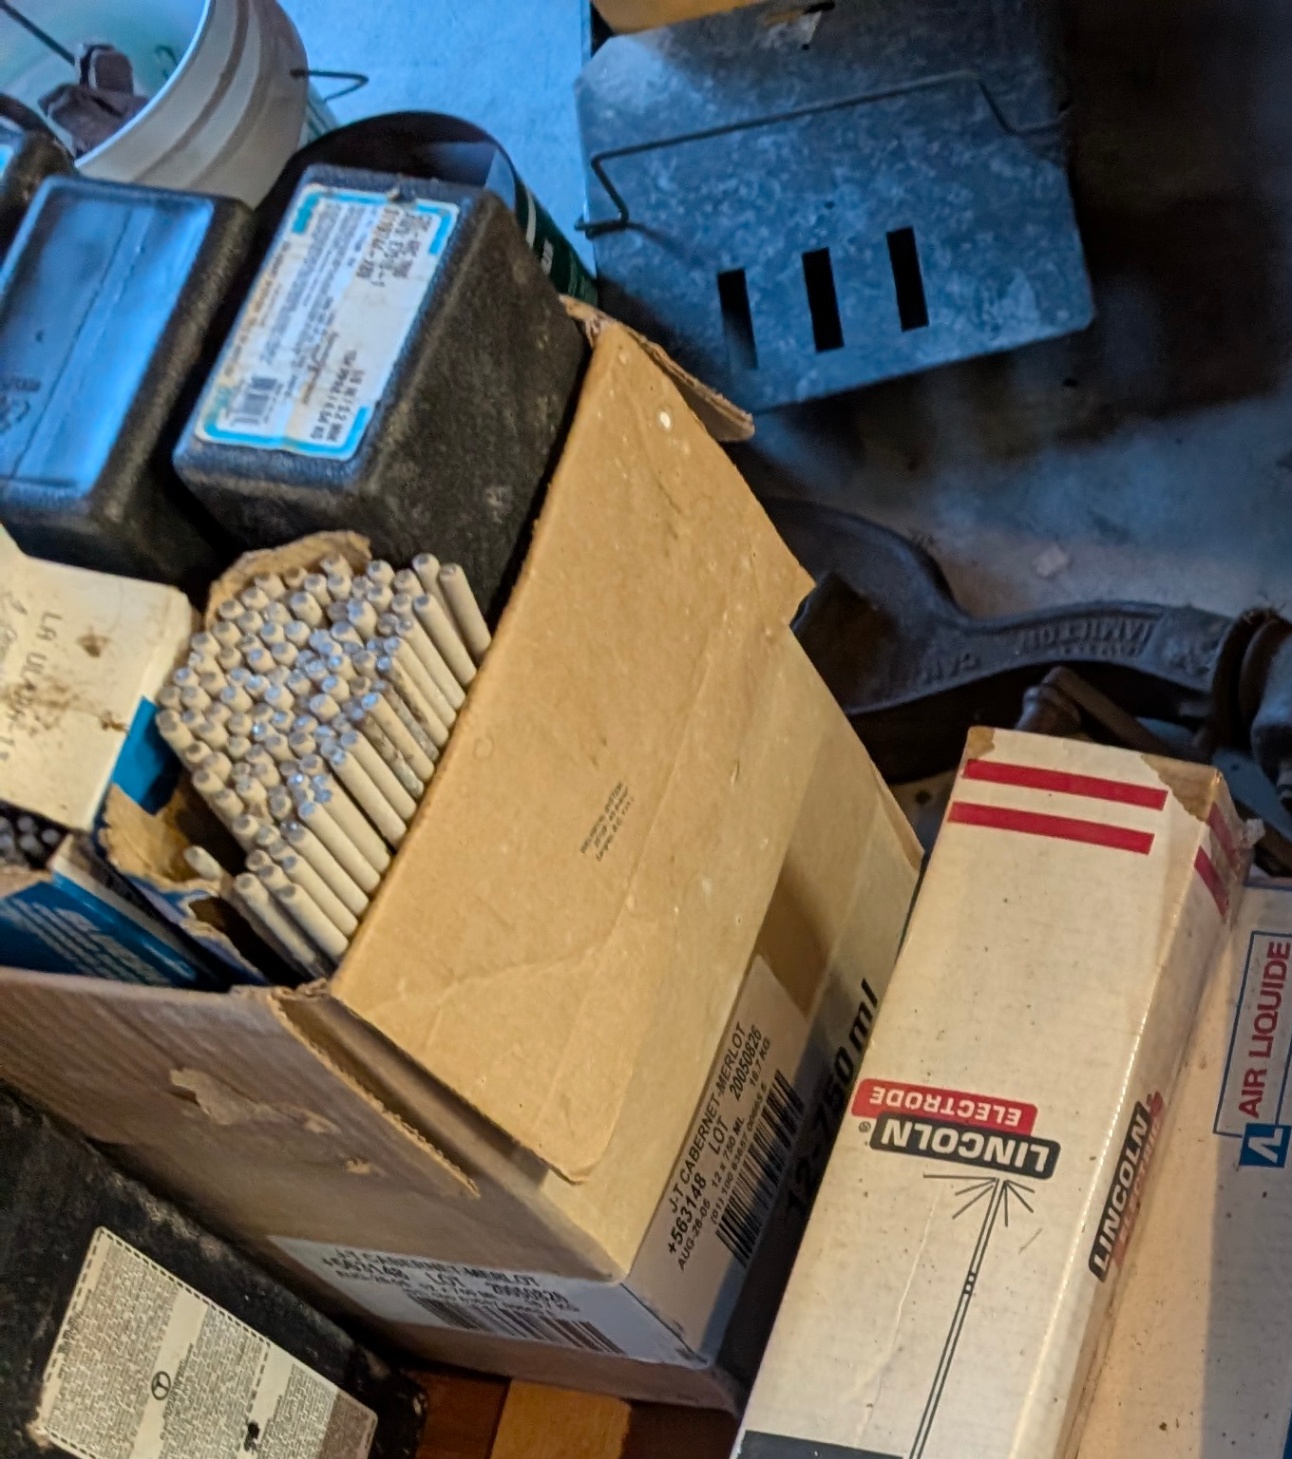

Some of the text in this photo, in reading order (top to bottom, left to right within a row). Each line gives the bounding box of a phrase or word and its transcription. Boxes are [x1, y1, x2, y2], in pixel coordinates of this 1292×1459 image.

[680, 1021, 746, 1186] CABERNET-MERLOT
[869, 1086, 1022, 1127] ELECTRODE
[1238, 942, 1292, 1119] AIR LIQUIDE
[667, 1023, 763, 1256] +563148 LOT 20050826
[1092, 1111, 1149, 1272] LINCOLN
